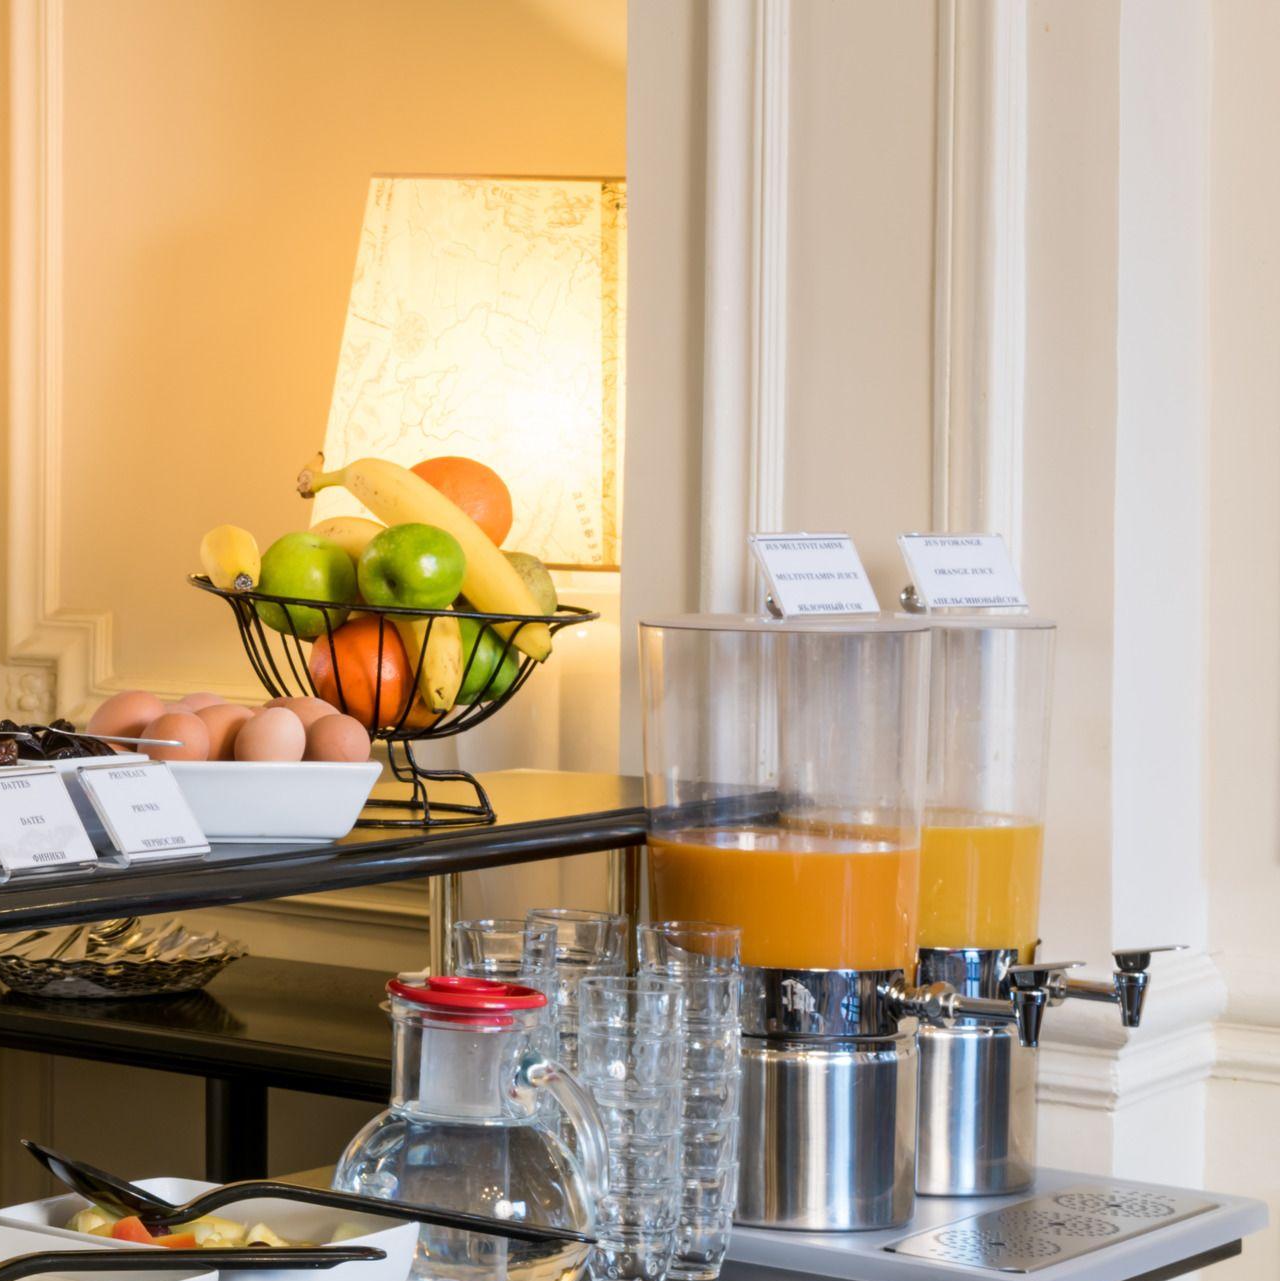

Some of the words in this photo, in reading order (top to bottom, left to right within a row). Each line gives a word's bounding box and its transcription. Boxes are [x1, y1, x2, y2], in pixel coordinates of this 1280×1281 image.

[108, 769, 146, 781] PRUNEAUX
[0, 779, 31, 791] DATTES
[132, 803, 160, 813] PRUNES
[20, 815, 46, 826] DATES
